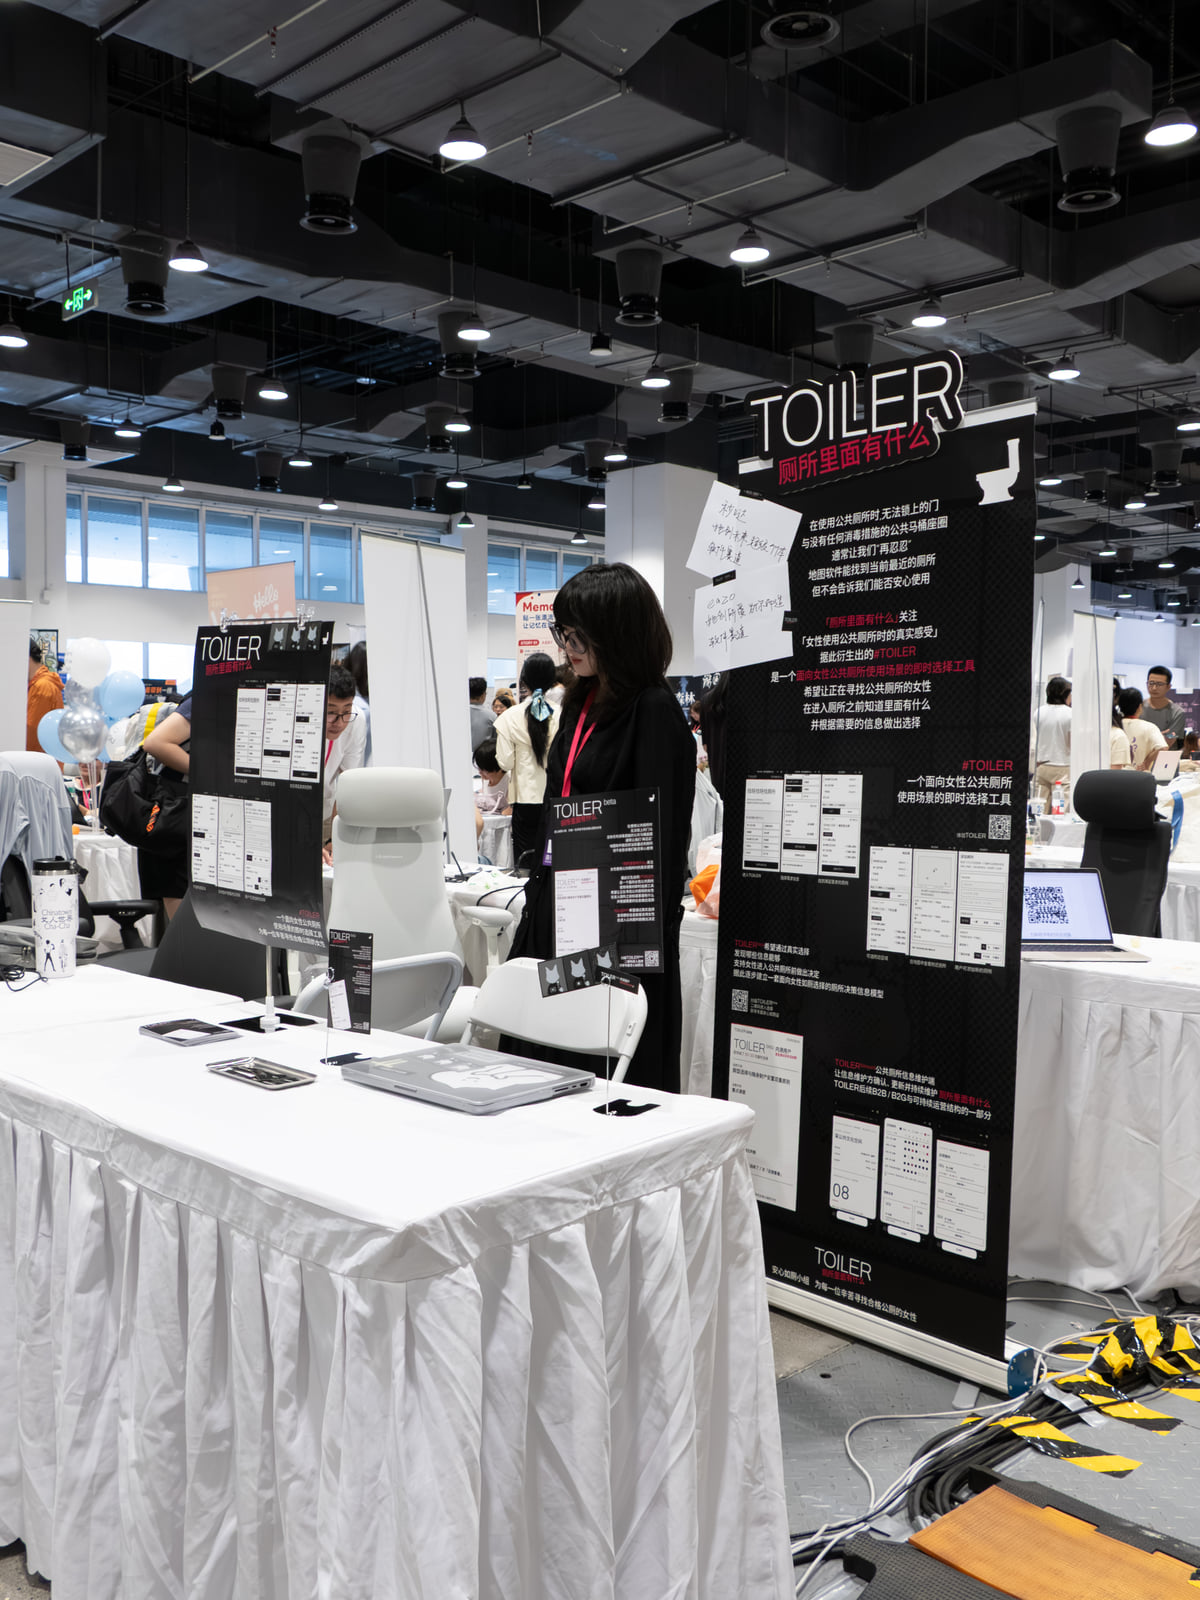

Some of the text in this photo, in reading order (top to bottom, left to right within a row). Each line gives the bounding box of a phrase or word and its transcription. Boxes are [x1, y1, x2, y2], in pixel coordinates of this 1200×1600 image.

[750, 361, 954, 452] TOILER
[778, 422, 930, 485] 厕所里面有什么
[801, 515, 949, 549] 与没有任何消毒措施的公共马桶座圈
[808, 553, 936, 581] 地图软件能找到当前最近的厕所
[812, 572, 931, 597] 但不会告诉我们能否安心使用
[253, 583, 279, 613] Hello
[801, 626, 938, 648] 「女性使用公共厕所时的真实感受」
[200, 635, 262, 662] TOILER
[770, 659, 975, 683] 是一个面向女性公共厕所使用场景的即时选择工具
[803, 680, 932, 697] 希望让正在寻找公共厕所的女性
[803, 698, 931, 715] 在进入厕所之前知道里面有什么
[810, 716, 921, 731] 并根据需要的信息做出选择
[962, 760, 1013, 771] #TOILER
[907, 775, 1013, 789] 一个面向女性公共厕所
[553, 800, 603, 819] TOILER
[897, 791, 1012, 806] 使用场景的即时选择工具
[734, 1038, 766, 1054] TOILER
[833, 1183, 850, 1200] 08
[814, 1246, 872, 1282] TOILER
